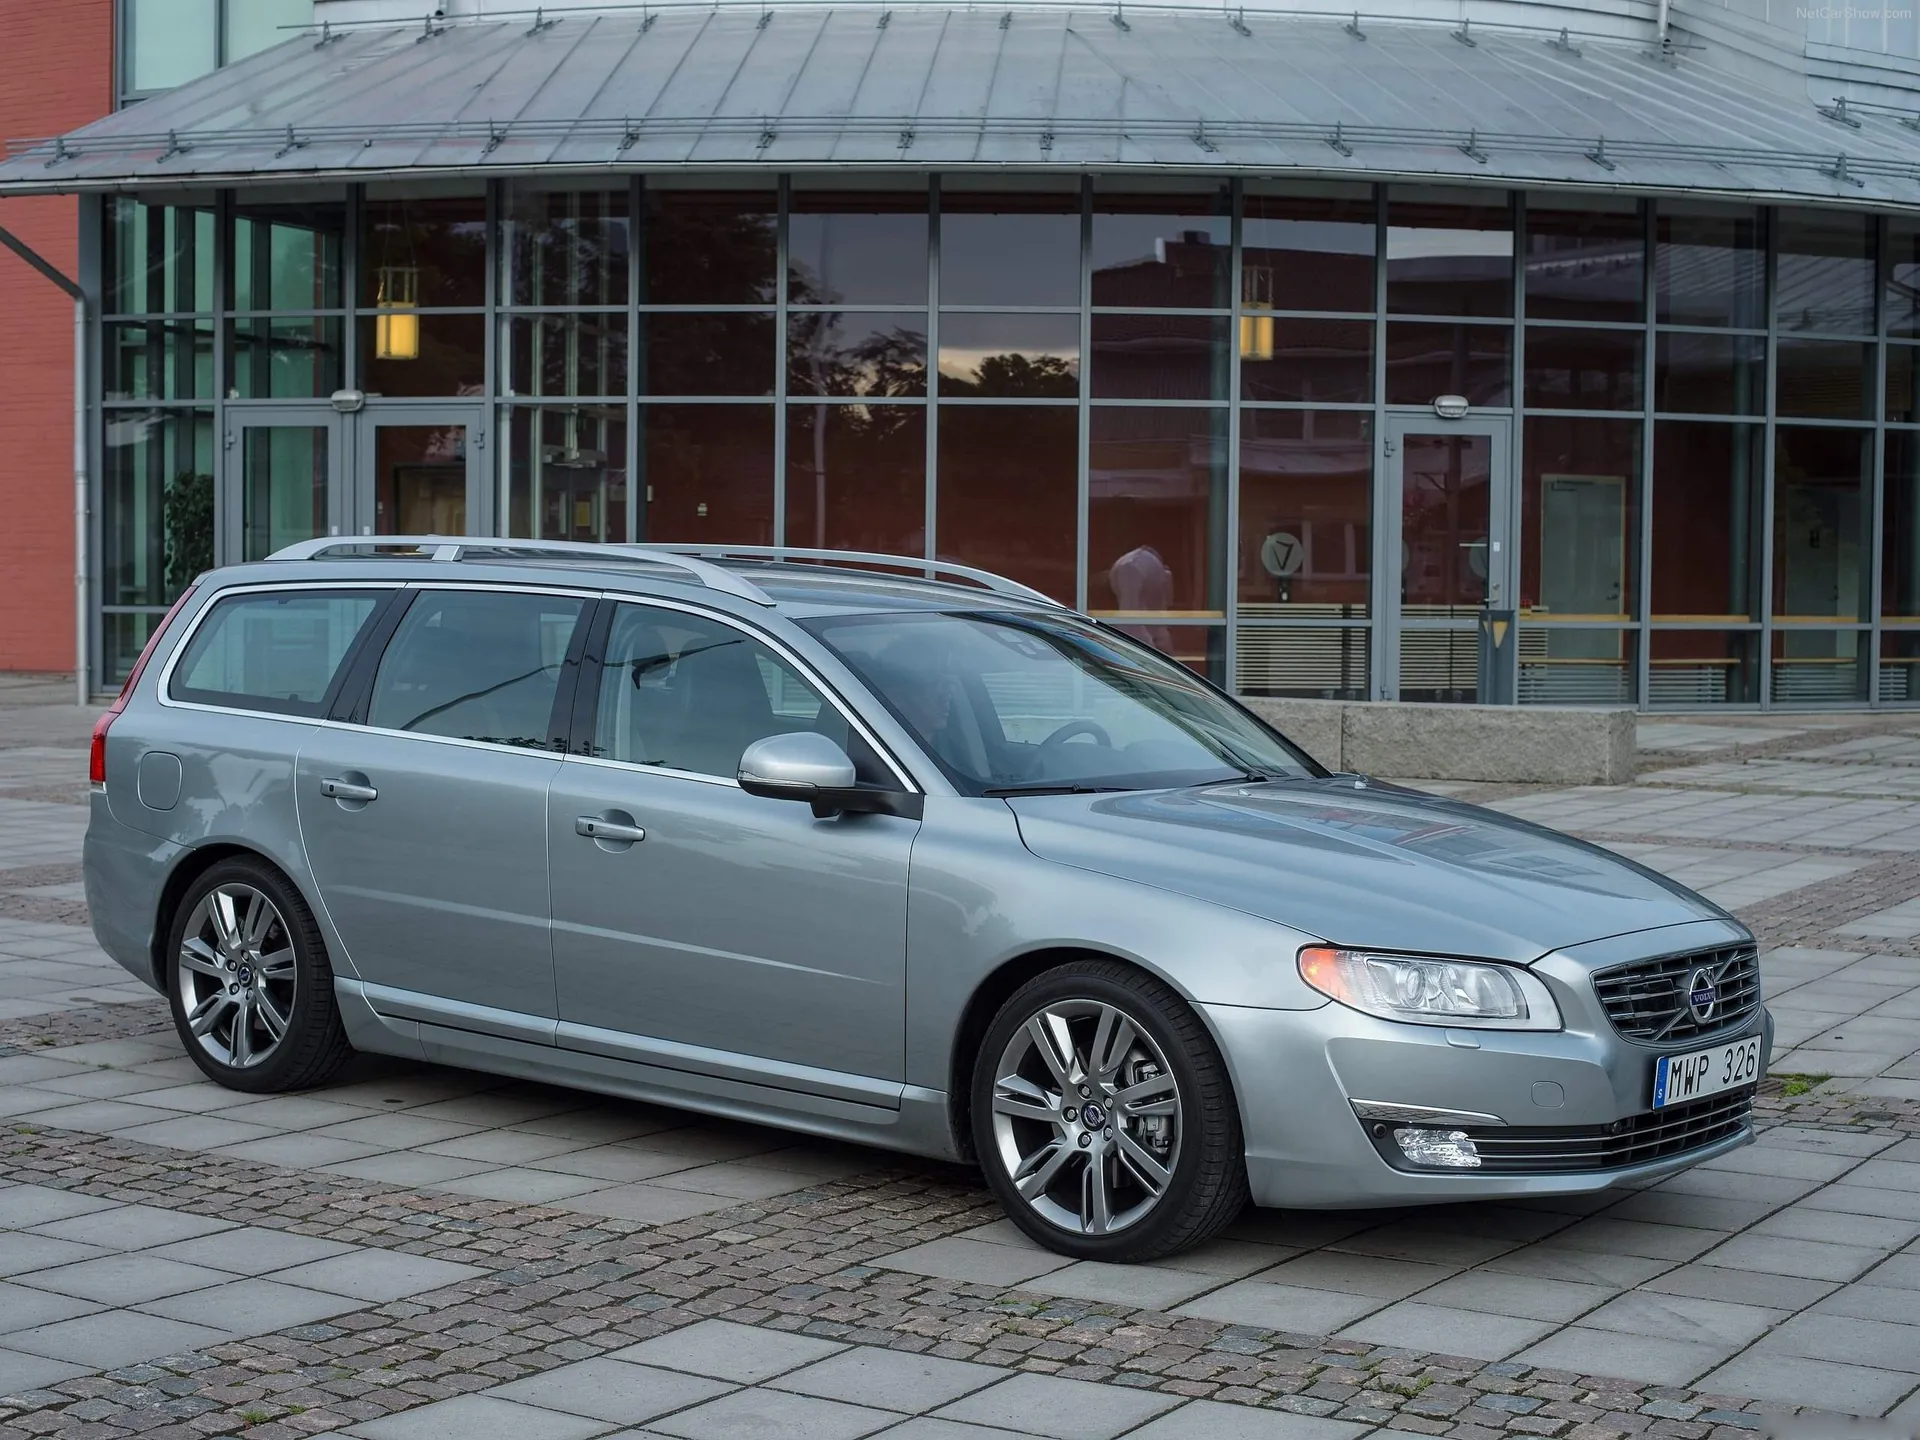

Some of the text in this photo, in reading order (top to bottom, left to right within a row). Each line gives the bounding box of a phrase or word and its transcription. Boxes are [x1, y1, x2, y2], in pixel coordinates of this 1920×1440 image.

[1668, 1042, 1756, 1099] MWP 326
[1658, 1088, 1663, 1099] S
